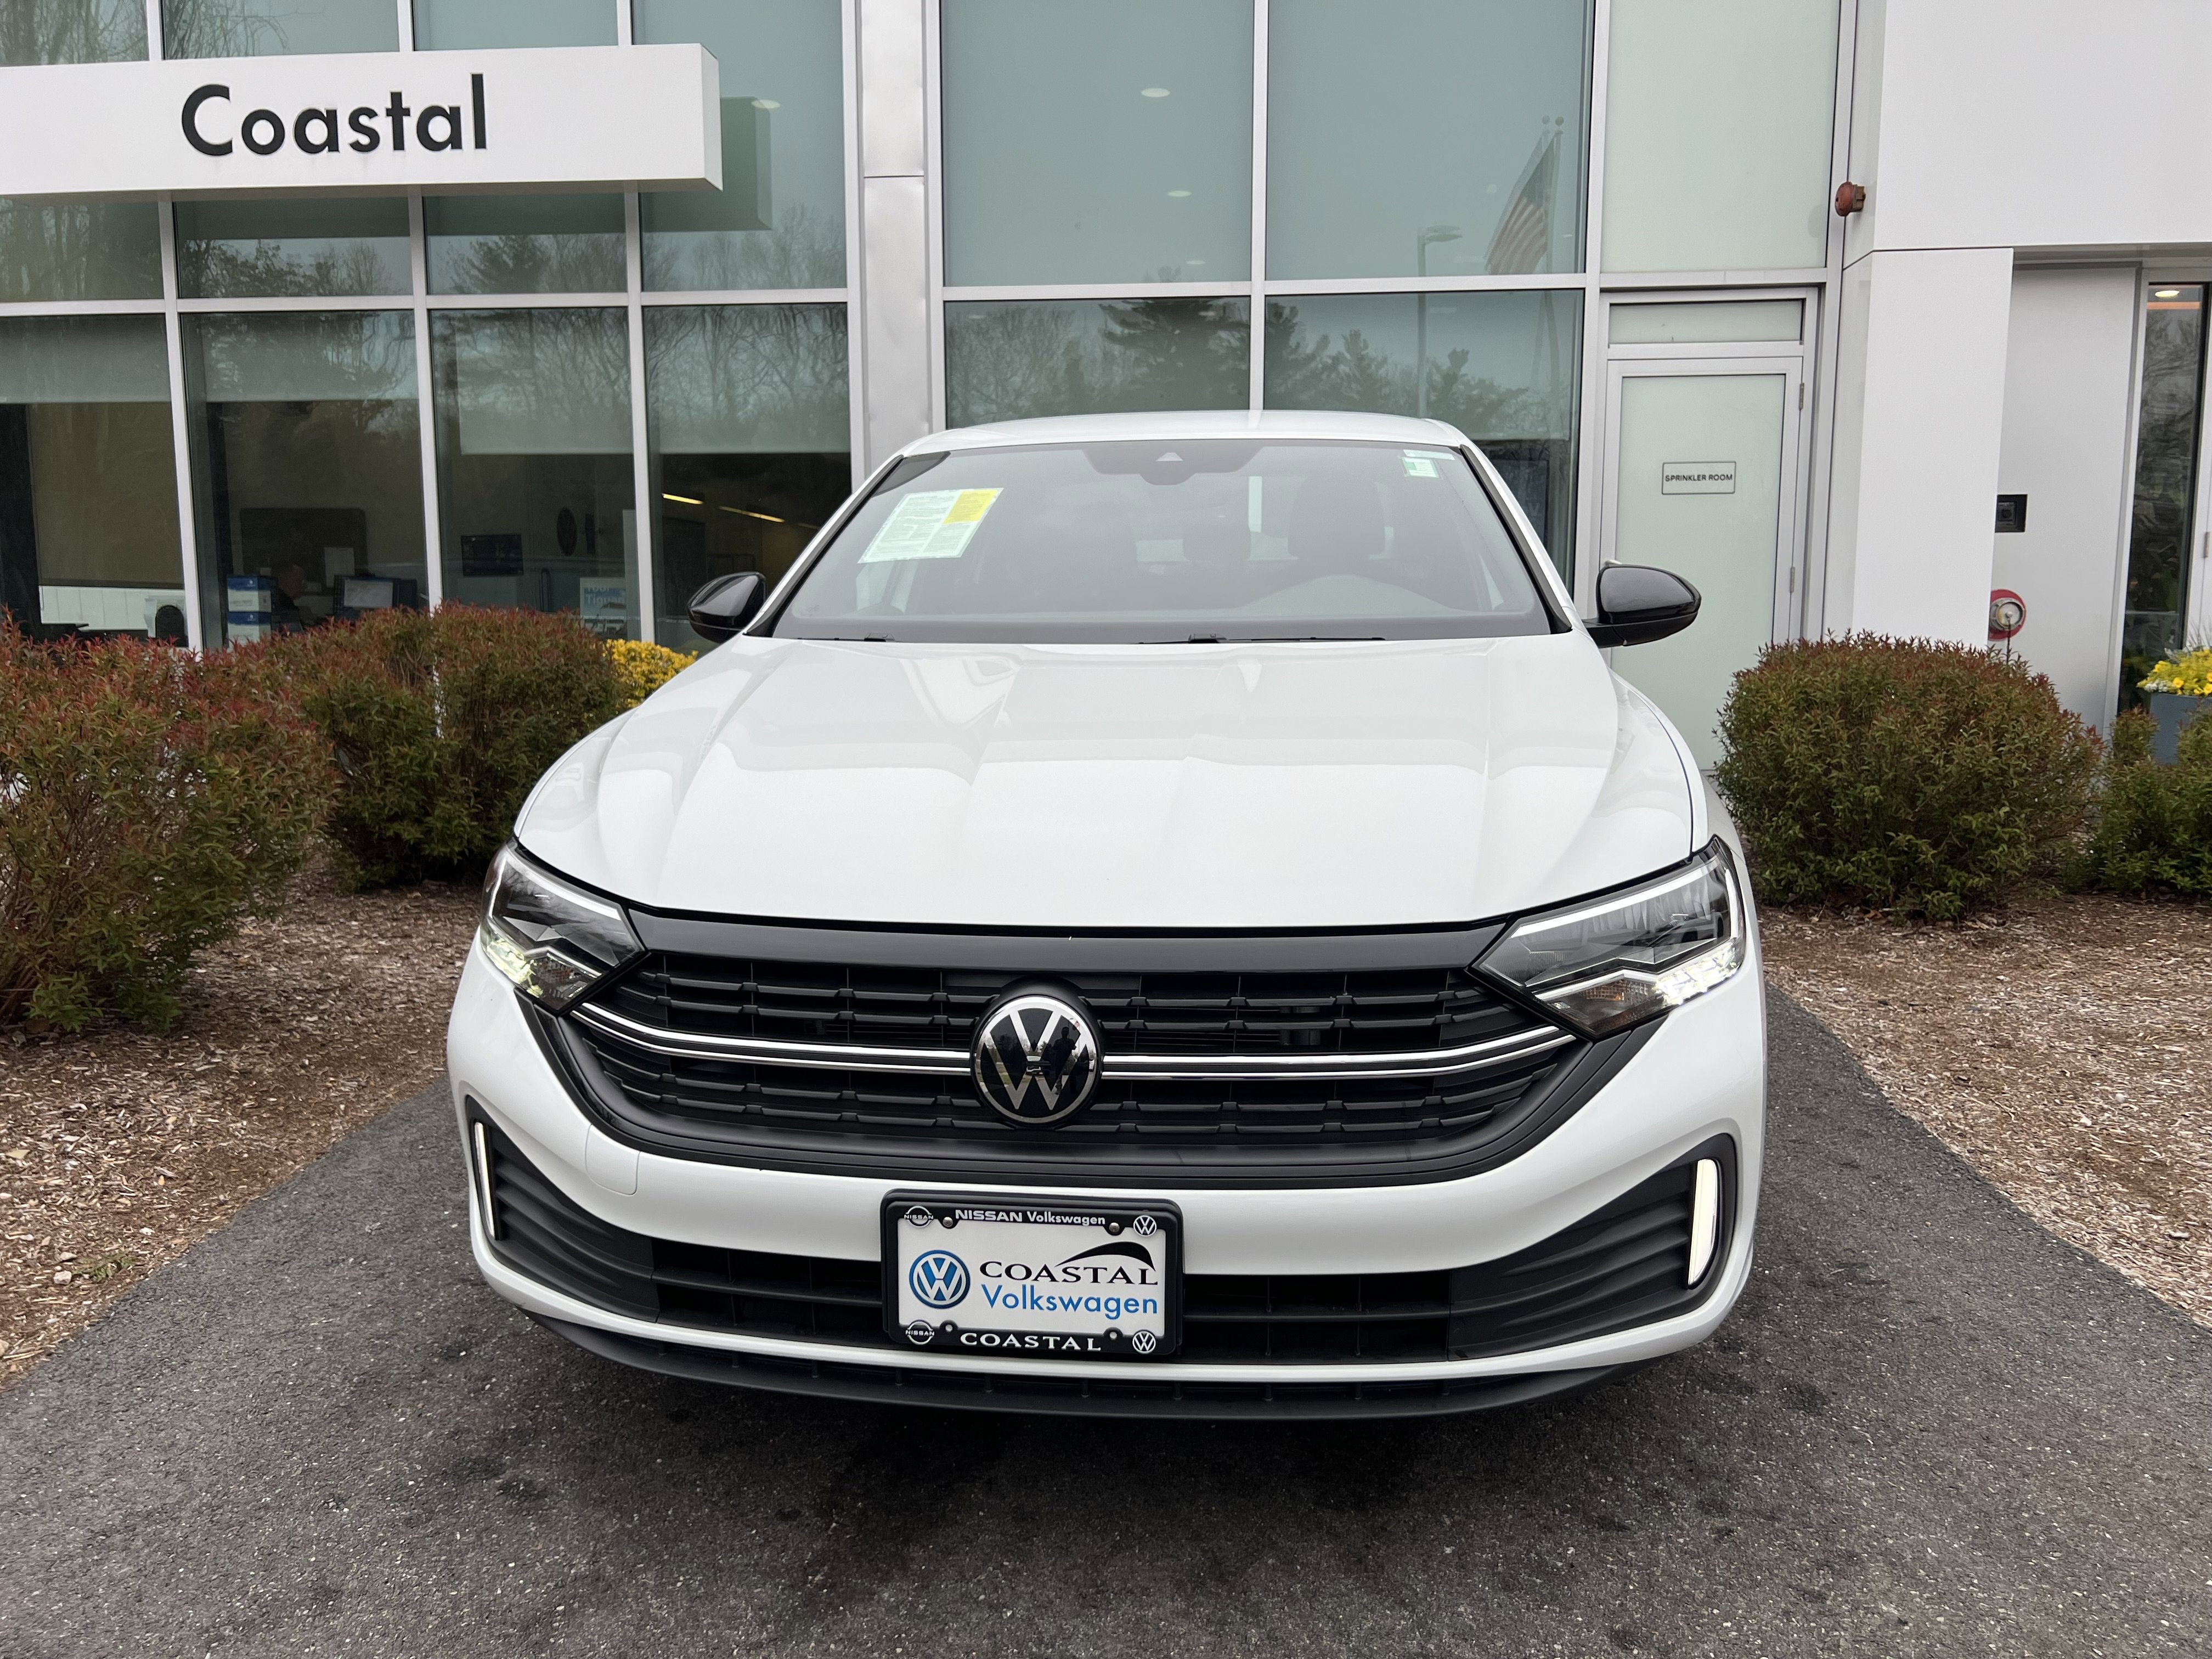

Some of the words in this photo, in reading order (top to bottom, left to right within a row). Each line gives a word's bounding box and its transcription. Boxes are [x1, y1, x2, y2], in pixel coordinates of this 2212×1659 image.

[181, 72, 487, 156] Coastal
[955, 1210, 1022, 1222] NISSAN
[1027, 1211, 1105, 1226] Volkswagen
[980, 1261, 1158, 1285] COASTAL
[981, 1284, 1158, 1319] Volkswagen
[960, 1333, 1101, 1351] COASTAL
